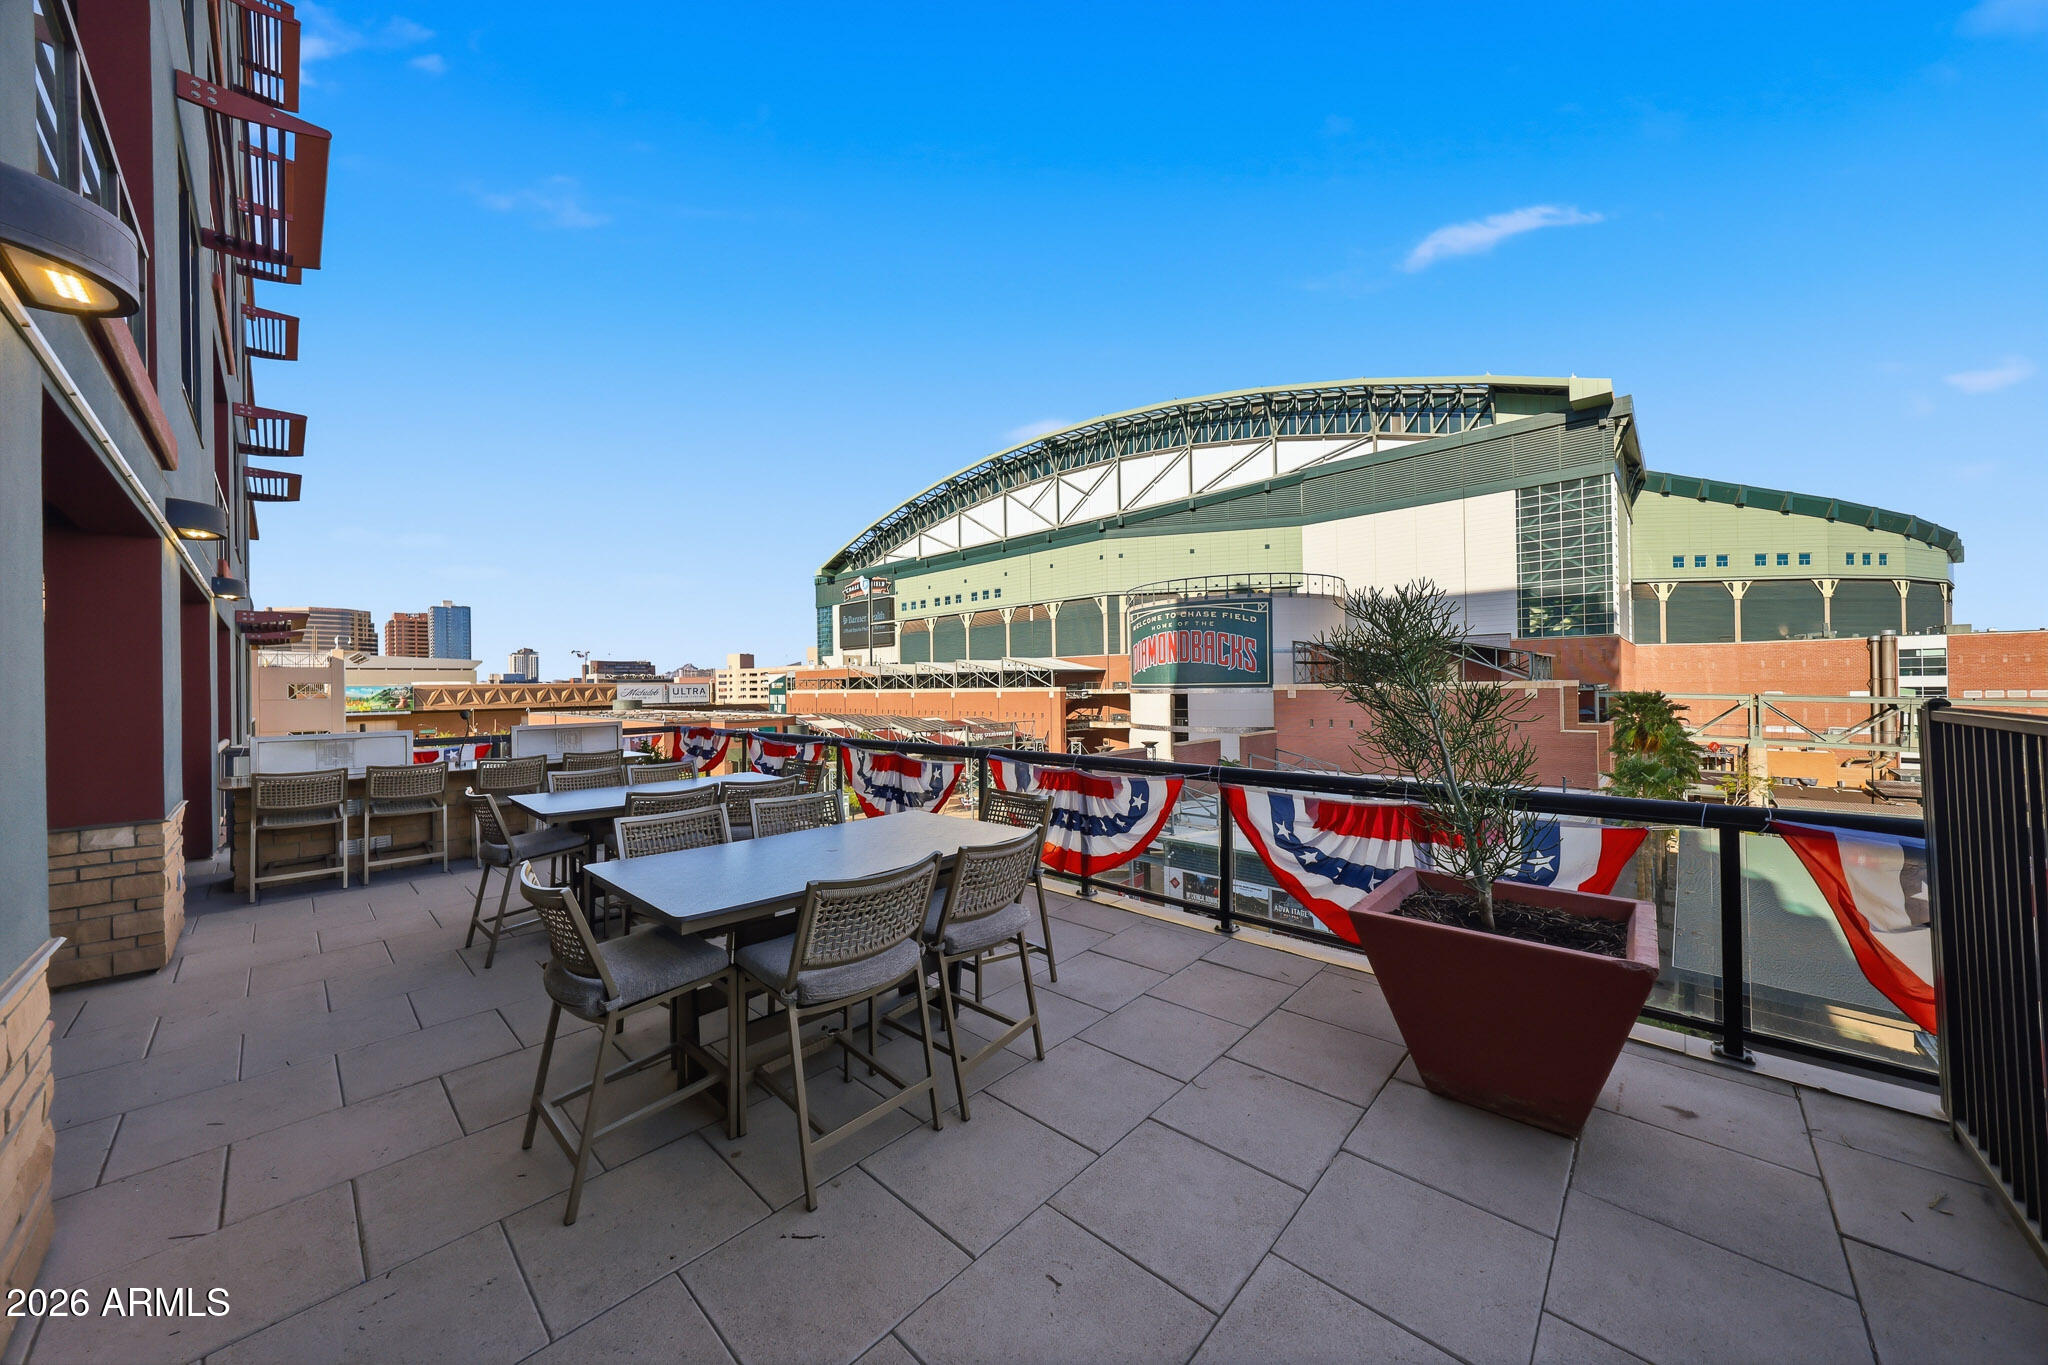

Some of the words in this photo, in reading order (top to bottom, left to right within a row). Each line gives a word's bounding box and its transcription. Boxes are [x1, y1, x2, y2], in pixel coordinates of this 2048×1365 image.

[1133, 614, 1163, 631] WELCOME
[1222, 612, 1257, 623] FIELD
[1151, 622, 1173, 631] HOME
[1133, 630, 1257, 676] DIAMONDBACKS
[672, 687, 706, 695] ULTRA
